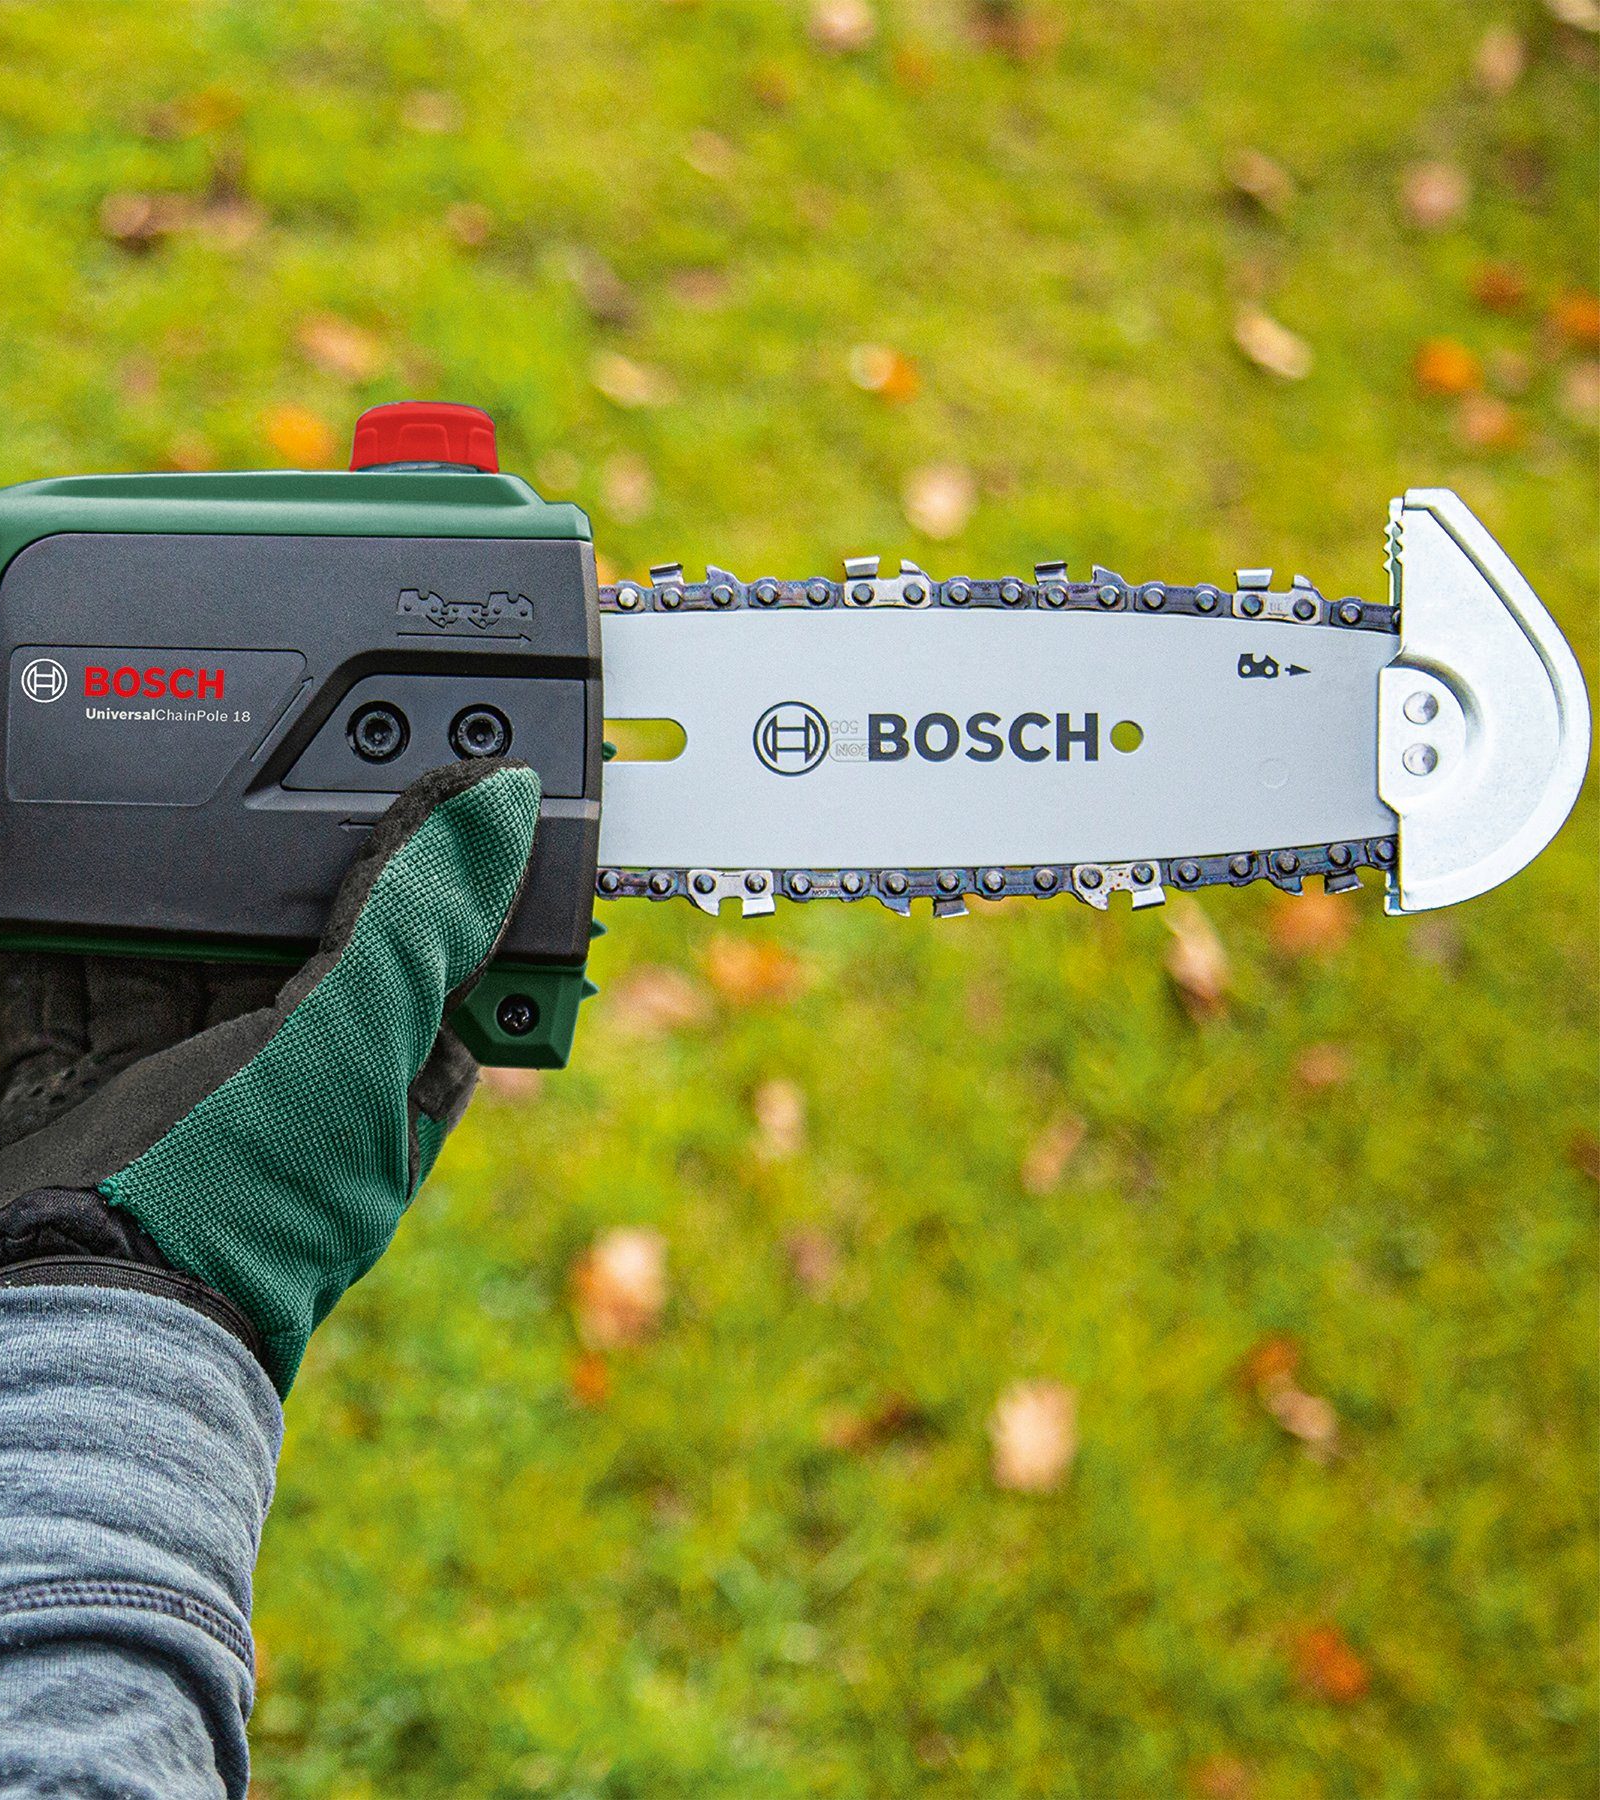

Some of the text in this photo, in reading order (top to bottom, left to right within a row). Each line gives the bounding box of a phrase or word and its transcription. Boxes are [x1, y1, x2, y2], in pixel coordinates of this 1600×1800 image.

[84, 666, 225, 700] BOSCH
[85, 707, 251, 723] UniversalChainPole 18
[868, 712, 1098, 763] BOSCH
